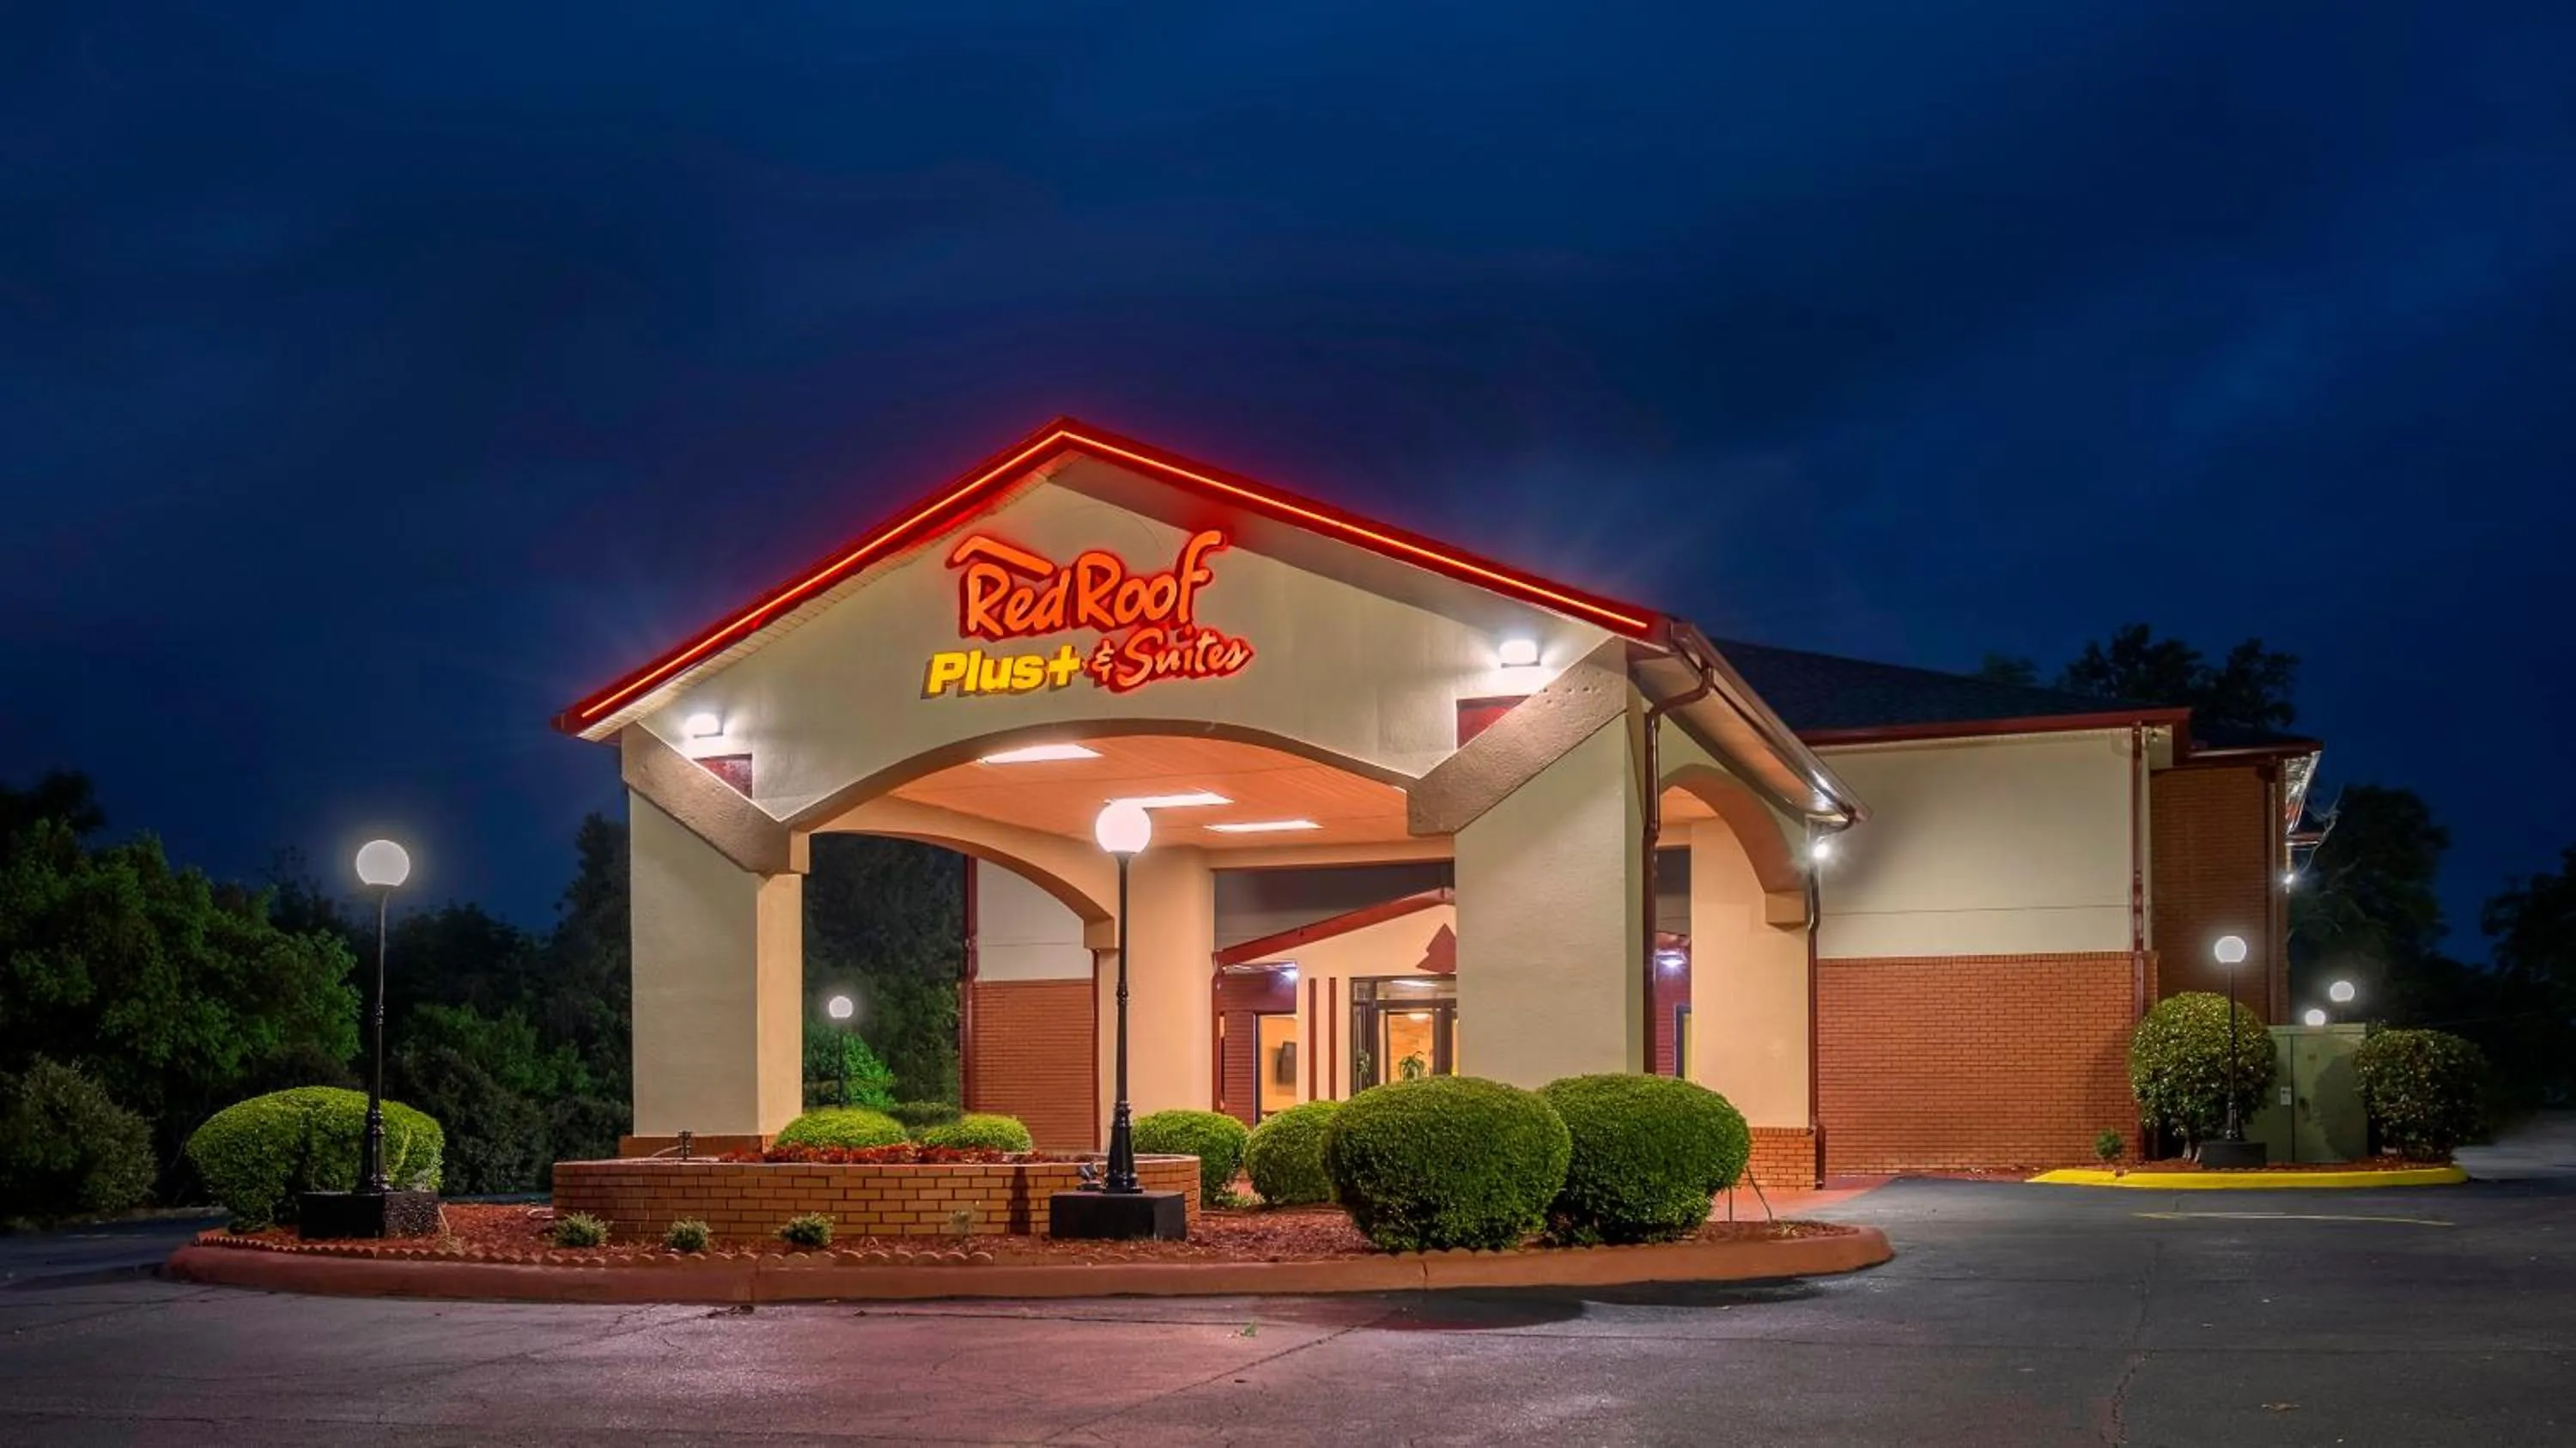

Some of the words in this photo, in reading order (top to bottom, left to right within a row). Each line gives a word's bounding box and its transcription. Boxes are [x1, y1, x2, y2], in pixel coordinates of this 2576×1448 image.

[927, 644, 1082, 695] Plus+
[1092, 638, 1115, 682] &
[1116, 624, 1251, 688] Suites
